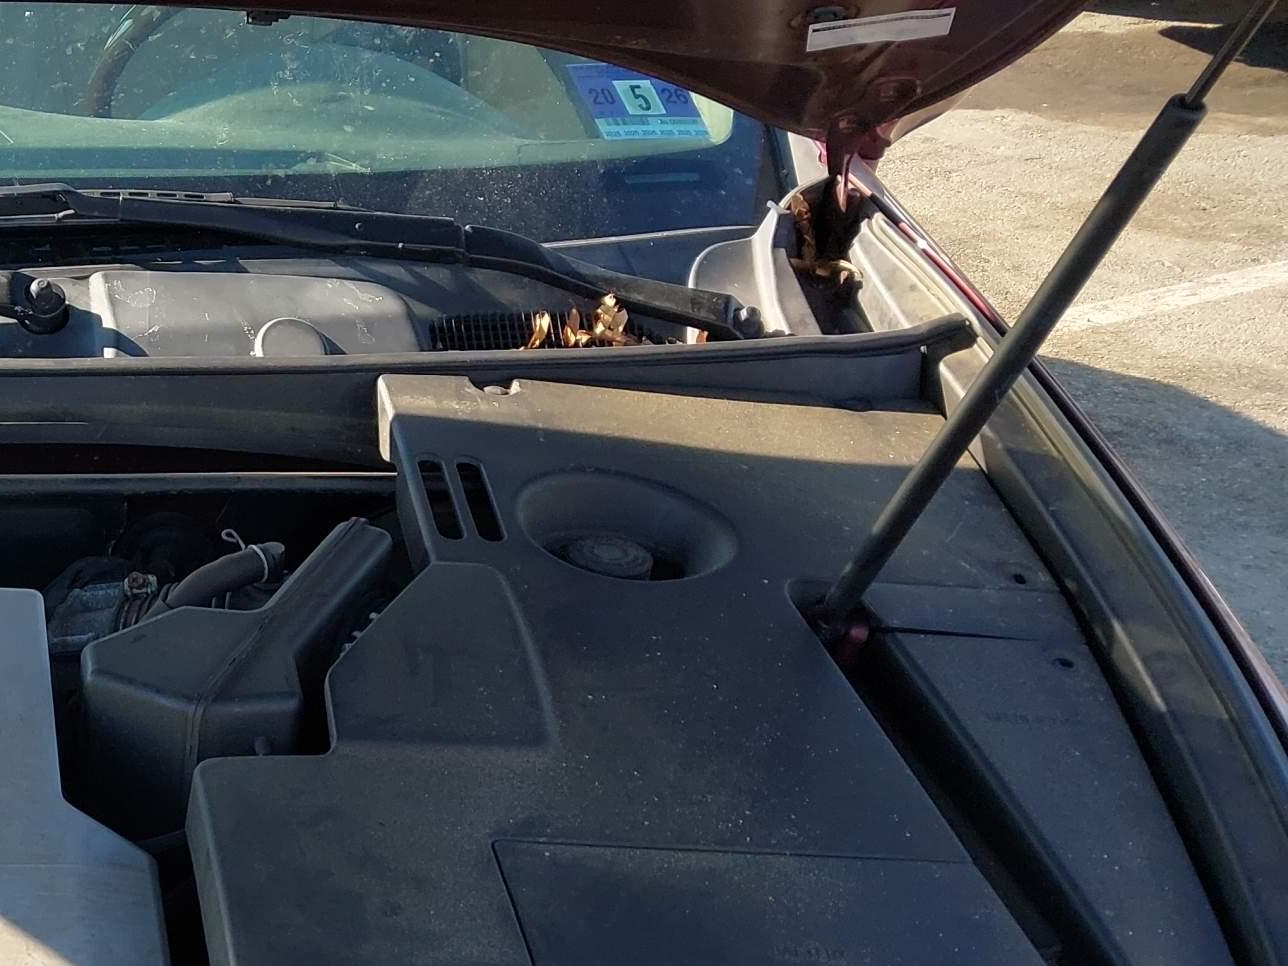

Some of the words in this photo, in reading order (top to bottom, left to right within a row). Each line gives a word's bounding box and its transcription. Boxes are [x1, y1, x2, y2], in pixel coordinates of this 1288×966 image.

[587, 87, 616, 105] 20
[629, 84, 652, 112] 5
[660, 87, 689, 105] 26
